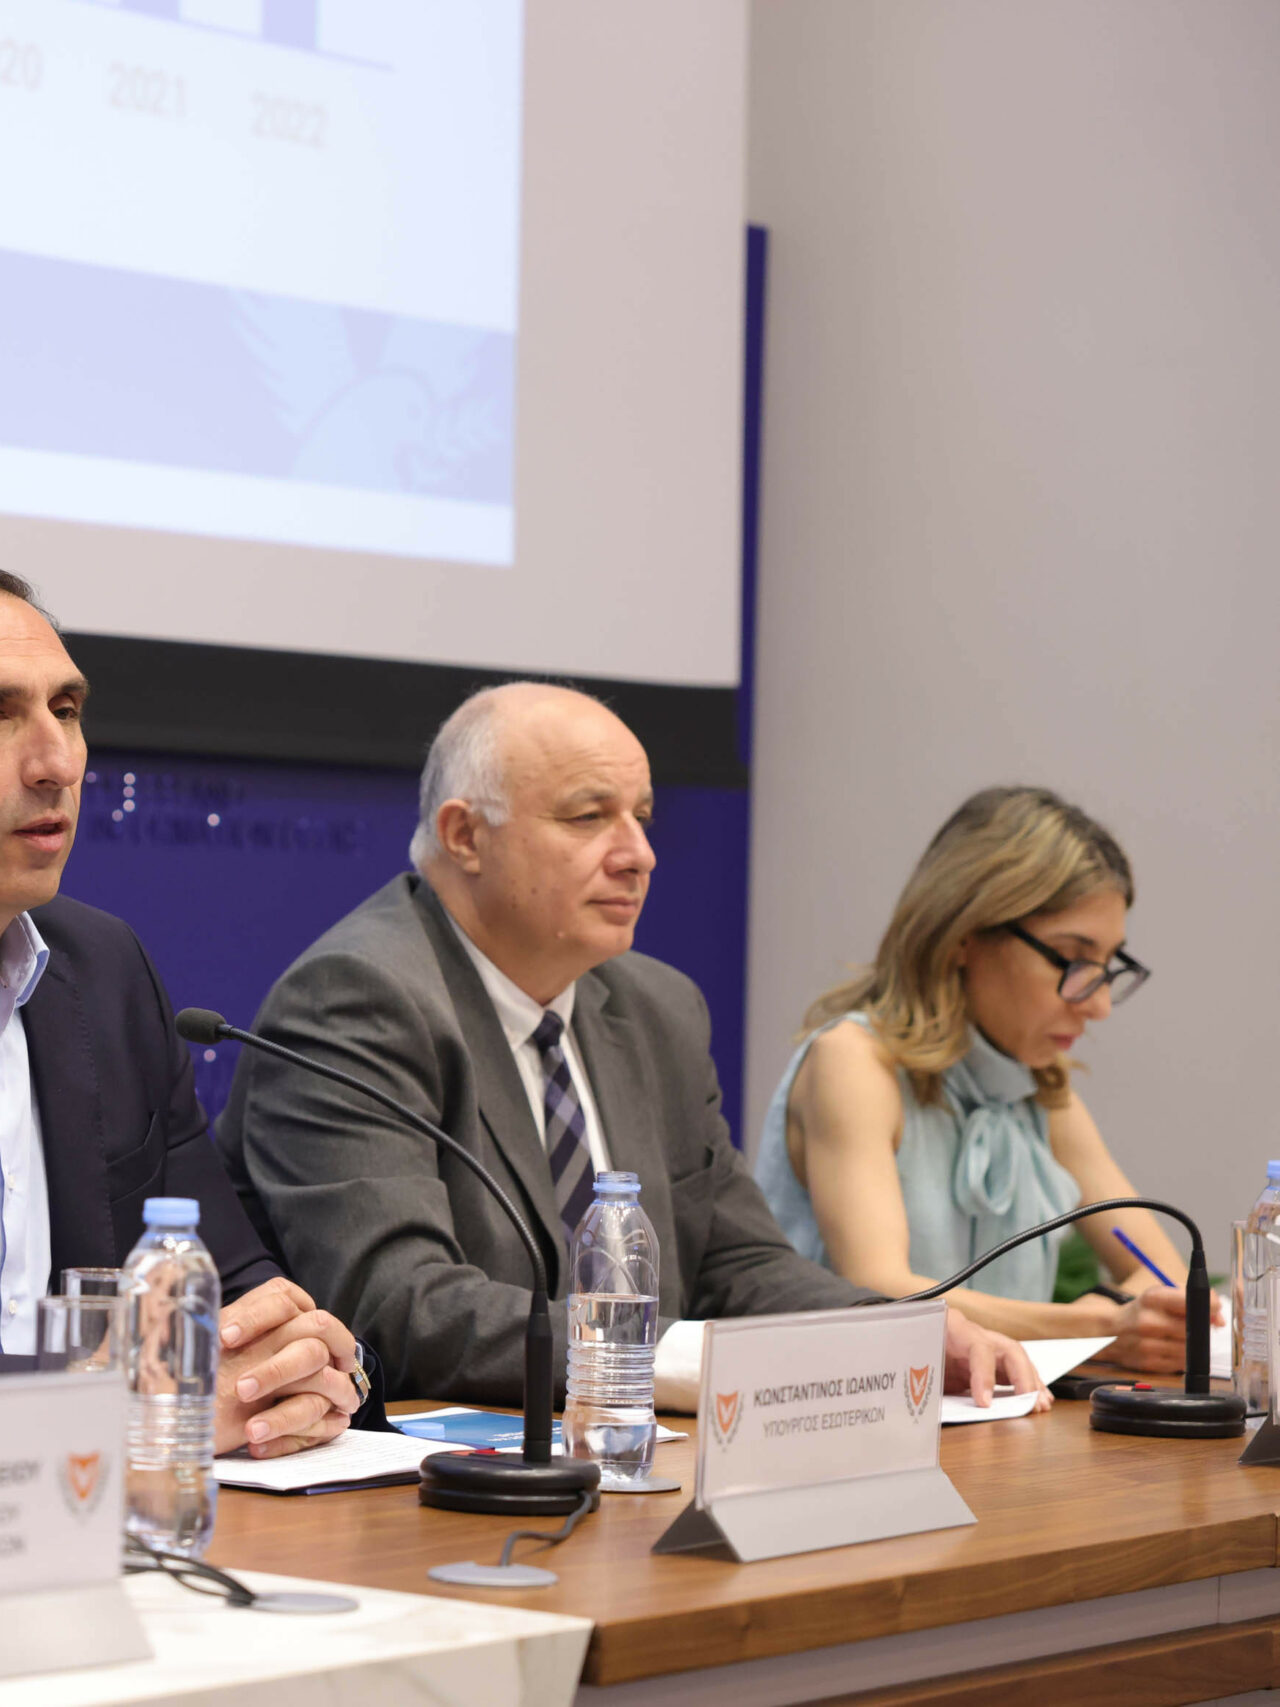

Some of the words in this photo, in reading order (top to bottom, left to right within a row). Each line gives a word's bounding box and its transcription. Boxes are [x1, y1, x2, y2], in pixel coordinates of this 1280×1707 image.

[106, 61, 188, 117] 2021
[248, 88, 330, 150] 2022
[754, 1378, 843, 1406] ΚΩΝΣΤΑΝΤΙΝΟΣ
[846, 1371, 897, 1396] ΙΩΑΝΝΟΥ
[763, 1414, 819, 1438] ΥΠΟΥΡΓΟΣ
[821, 1405, 886, 1431] ΕΣΩΤΕΡΙΚΩΝ
